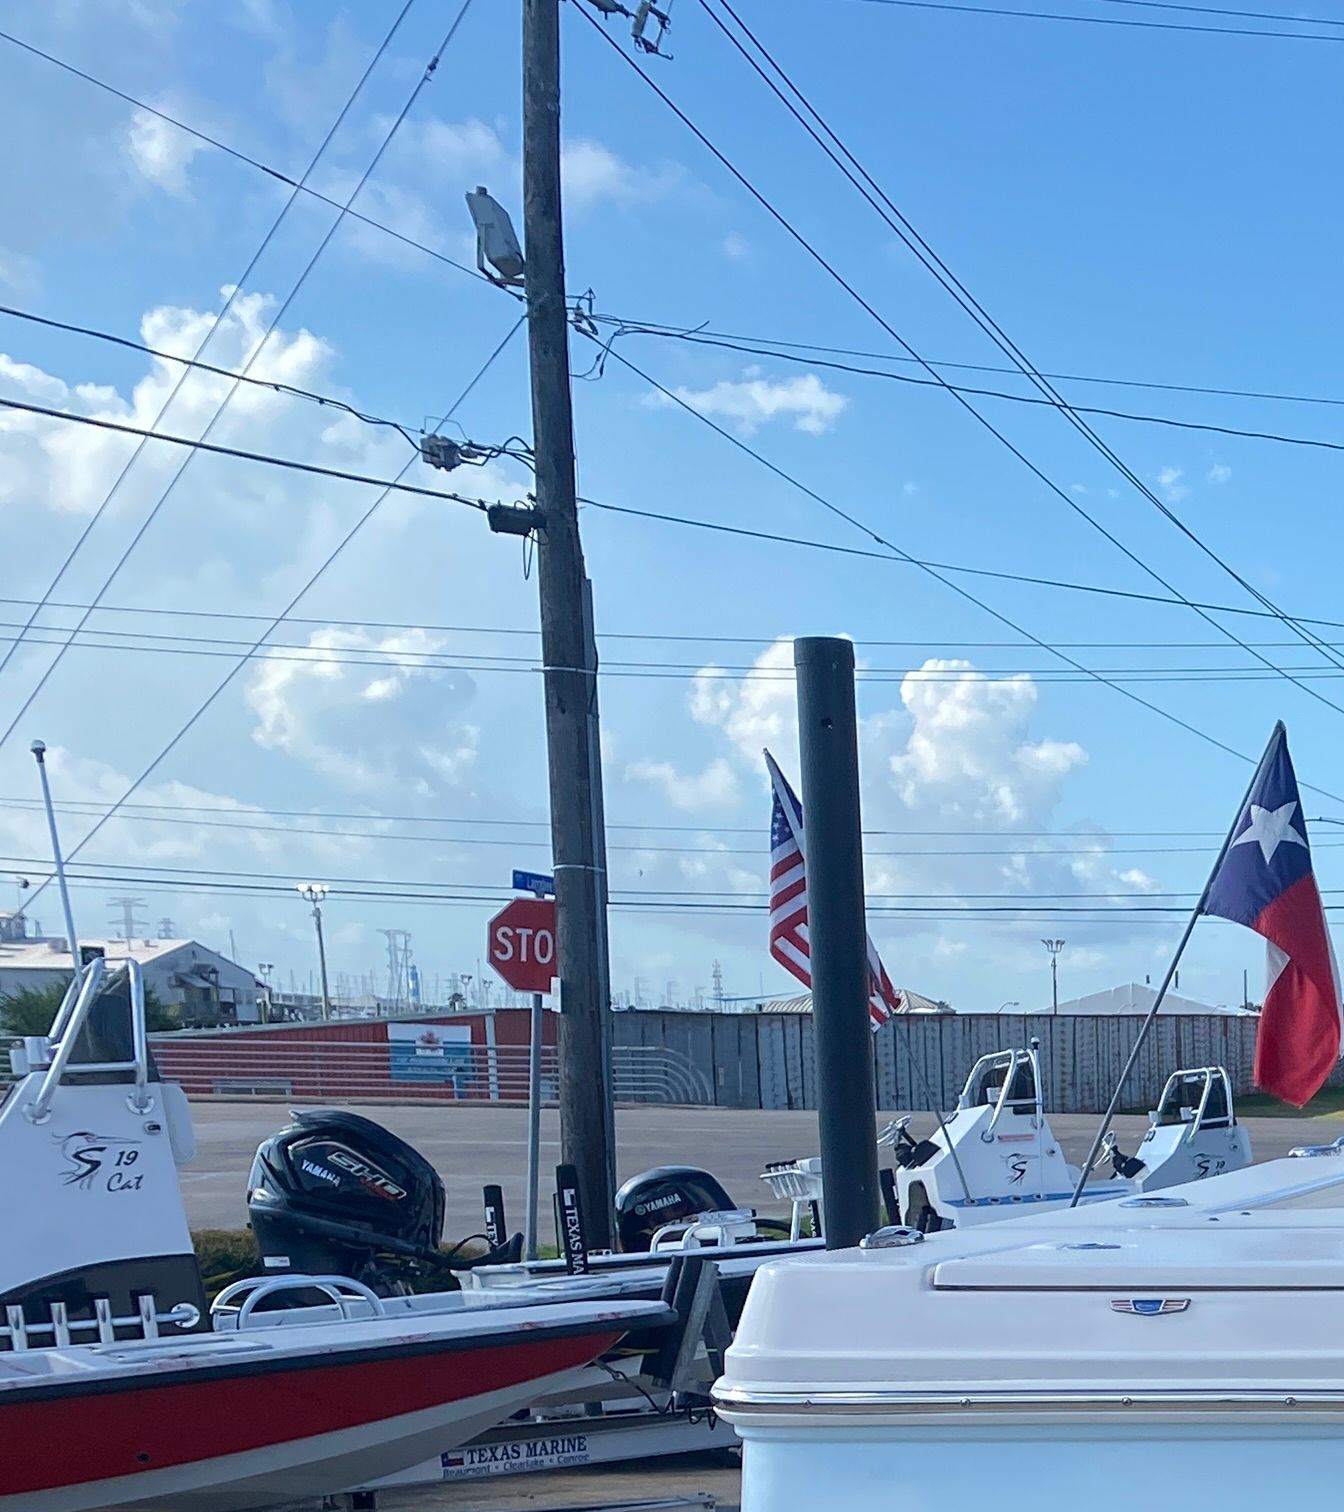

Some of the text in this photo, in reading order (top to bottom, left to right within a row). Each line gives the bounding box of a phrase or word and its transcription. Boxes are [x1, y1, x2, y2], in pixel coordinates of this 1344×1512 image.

[493, 926, 554, 964] STO
[115, 1150, 139, 1166] 19
[107, 1172, 144, 1192] Cat
[301, 1159, 341, 1187] YAMAHA
[644, 1193, 681, 1212] YAMAHA
[565, 1207, 583, 1250] TEXAS
[466, 1435, 587, 1465] TEXAS MARINE
[443, 1464, 491, 1479] Beaumont
[557, 1453, 590, 1465] Conroe
